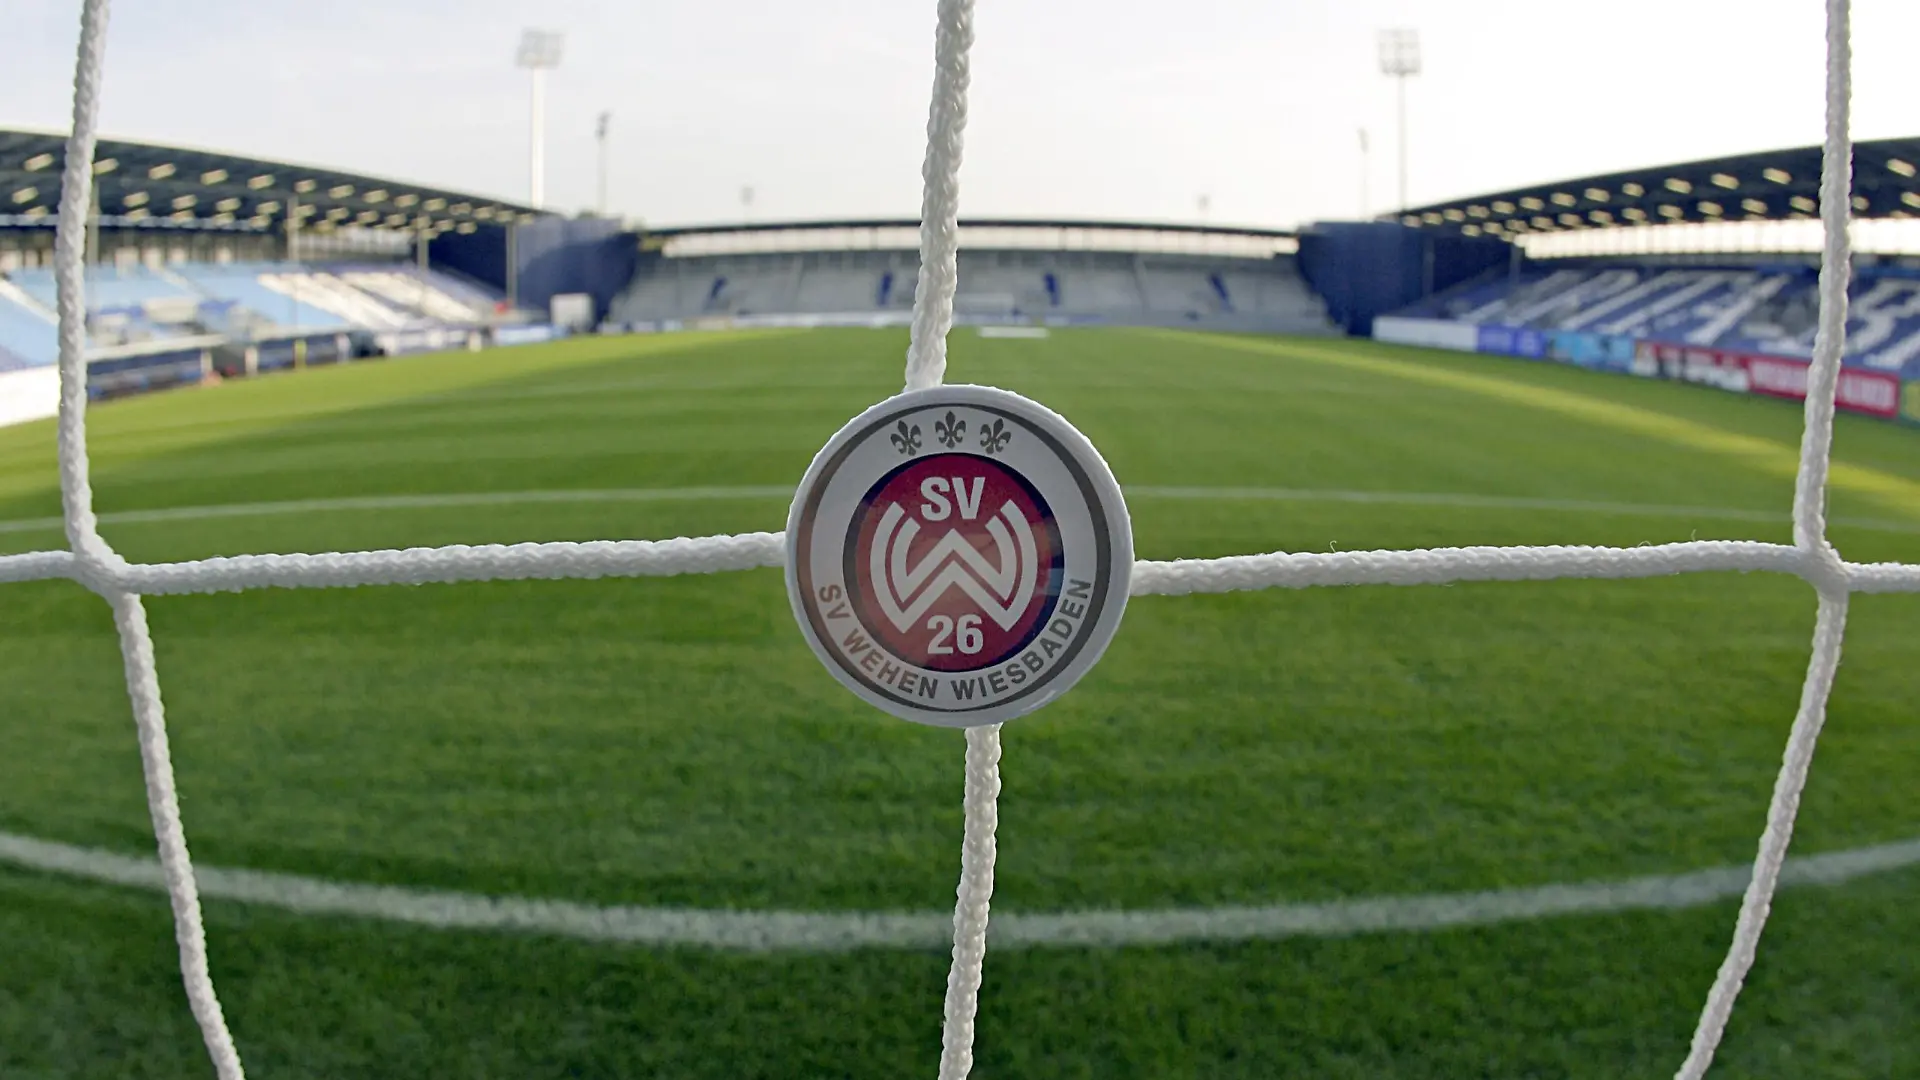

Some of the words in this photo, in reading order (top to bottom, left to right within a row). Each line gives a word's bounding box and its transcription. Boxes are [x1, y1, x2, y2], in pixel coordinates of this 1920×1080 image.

[920, 476, 985, 521] SV
[819, 584, 851, 621] SV
[843, 627, 938, 699] WEHEN
[951, 578, 1091, 700] WIESBADEN
[927, 615, 984, 654] 26
